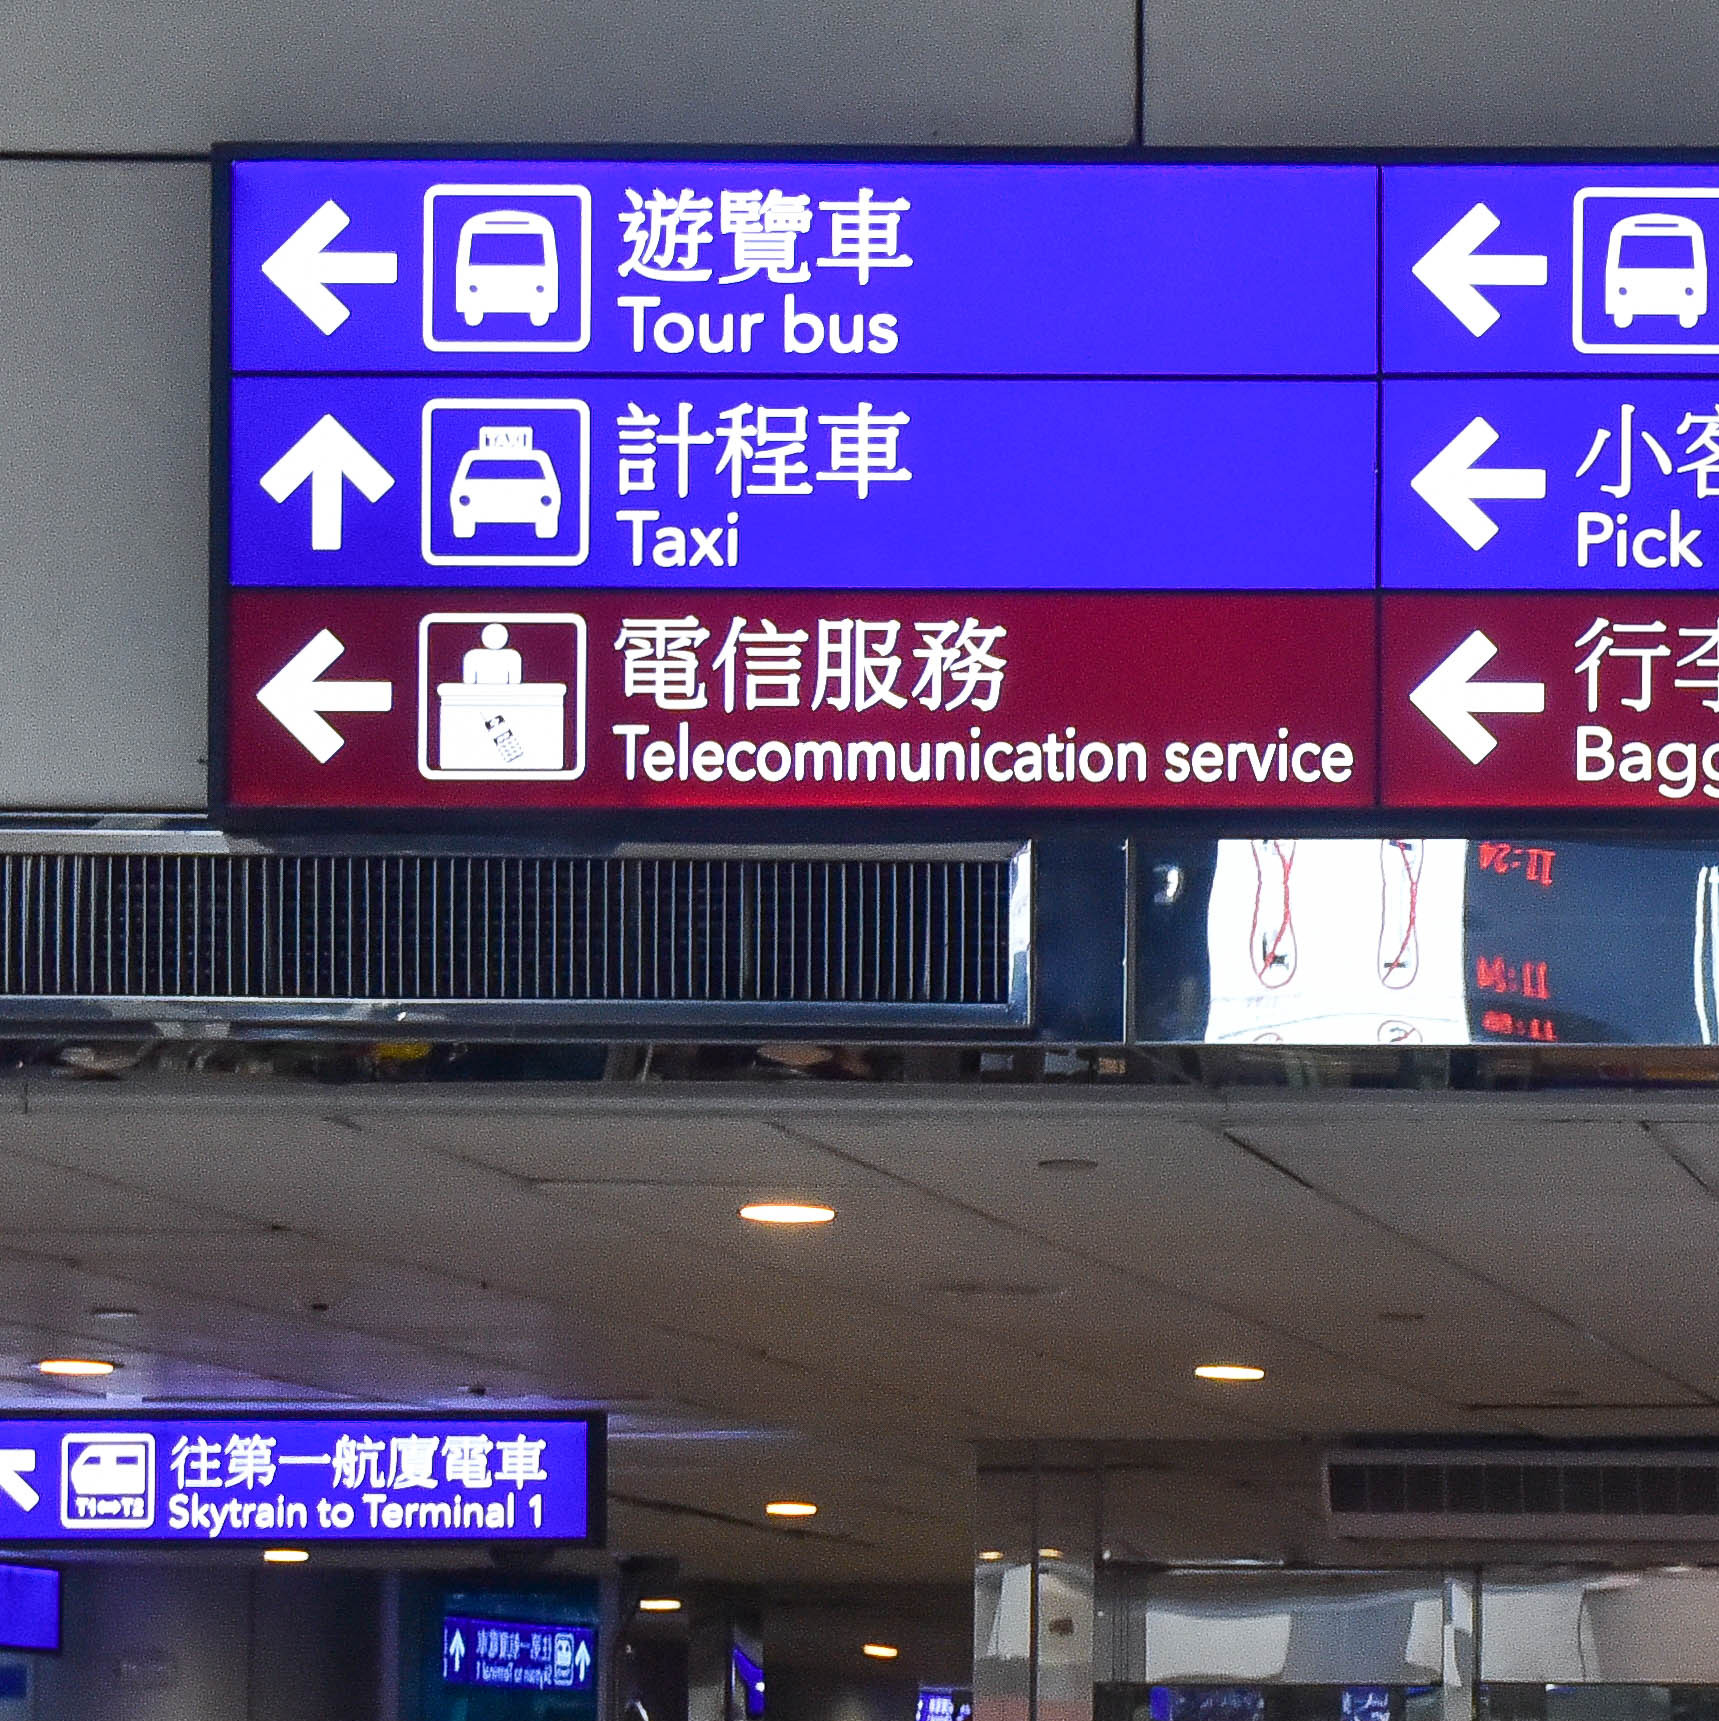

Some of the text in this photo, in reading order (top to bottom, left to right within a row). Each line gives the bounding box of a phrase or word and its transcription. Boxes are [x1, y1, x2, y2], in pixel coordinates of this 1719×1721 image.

[617, 186, 914, 286] 遊覽車
[616, 292, 899, 355] Tour bus
[616, 401, 913, 500] 計程車
[615, 509, 739, 568] Taxi
[1577, 508, 1704, 569] Pick
[613, 614, 1008, 714] 電信服務
[611, 720, 1354, 783] Telecommunication service
[169, 1433, 548, 1491] 往第一航廈電車
[76, 1497, 97, 1518] T1
[168, 1491, 542, 1538] Skytrain to Terminal 1
